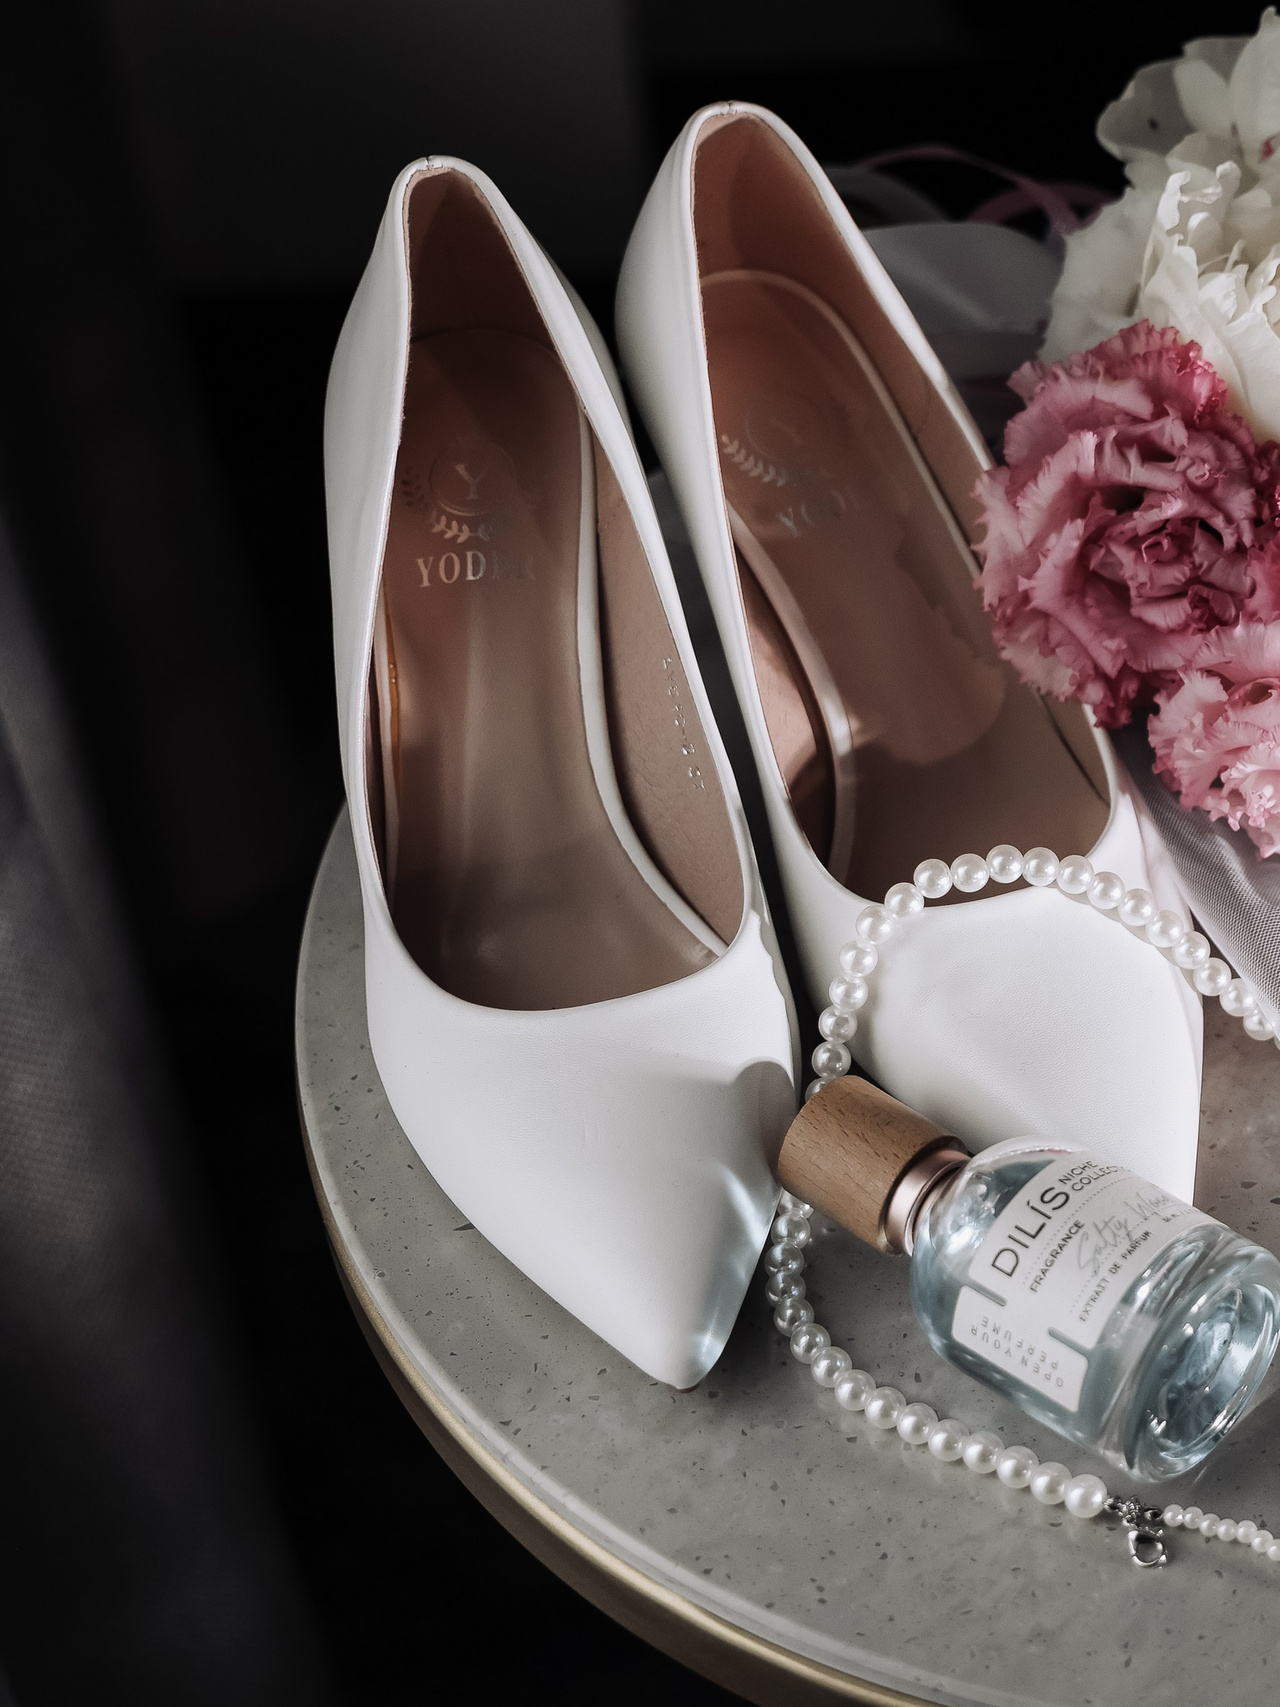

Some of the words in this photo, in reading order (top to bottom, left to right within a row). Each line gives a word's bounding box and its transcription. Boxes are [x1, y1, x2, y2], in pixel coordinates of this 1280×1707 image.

[415, 550, 534, 588] YOD
[1058, 1160, 1099, 1185] NICHE
[991, 1186, 1070, 1277] DILÍS
[1029, 1219, 1085, 1293] FRAGRANCE
[1079, 1276, 1110, 1322] EXTRAIT
[1108, 1260, 1123, 1275] DE
[1120, 1230, 1153, 1260] PARFUM
[970, 1325, 1013, 1357] YOUR
[980, 1315, 1060, 1370] PERFUME
[1020, 1355, 1064, 1388] OPEN
